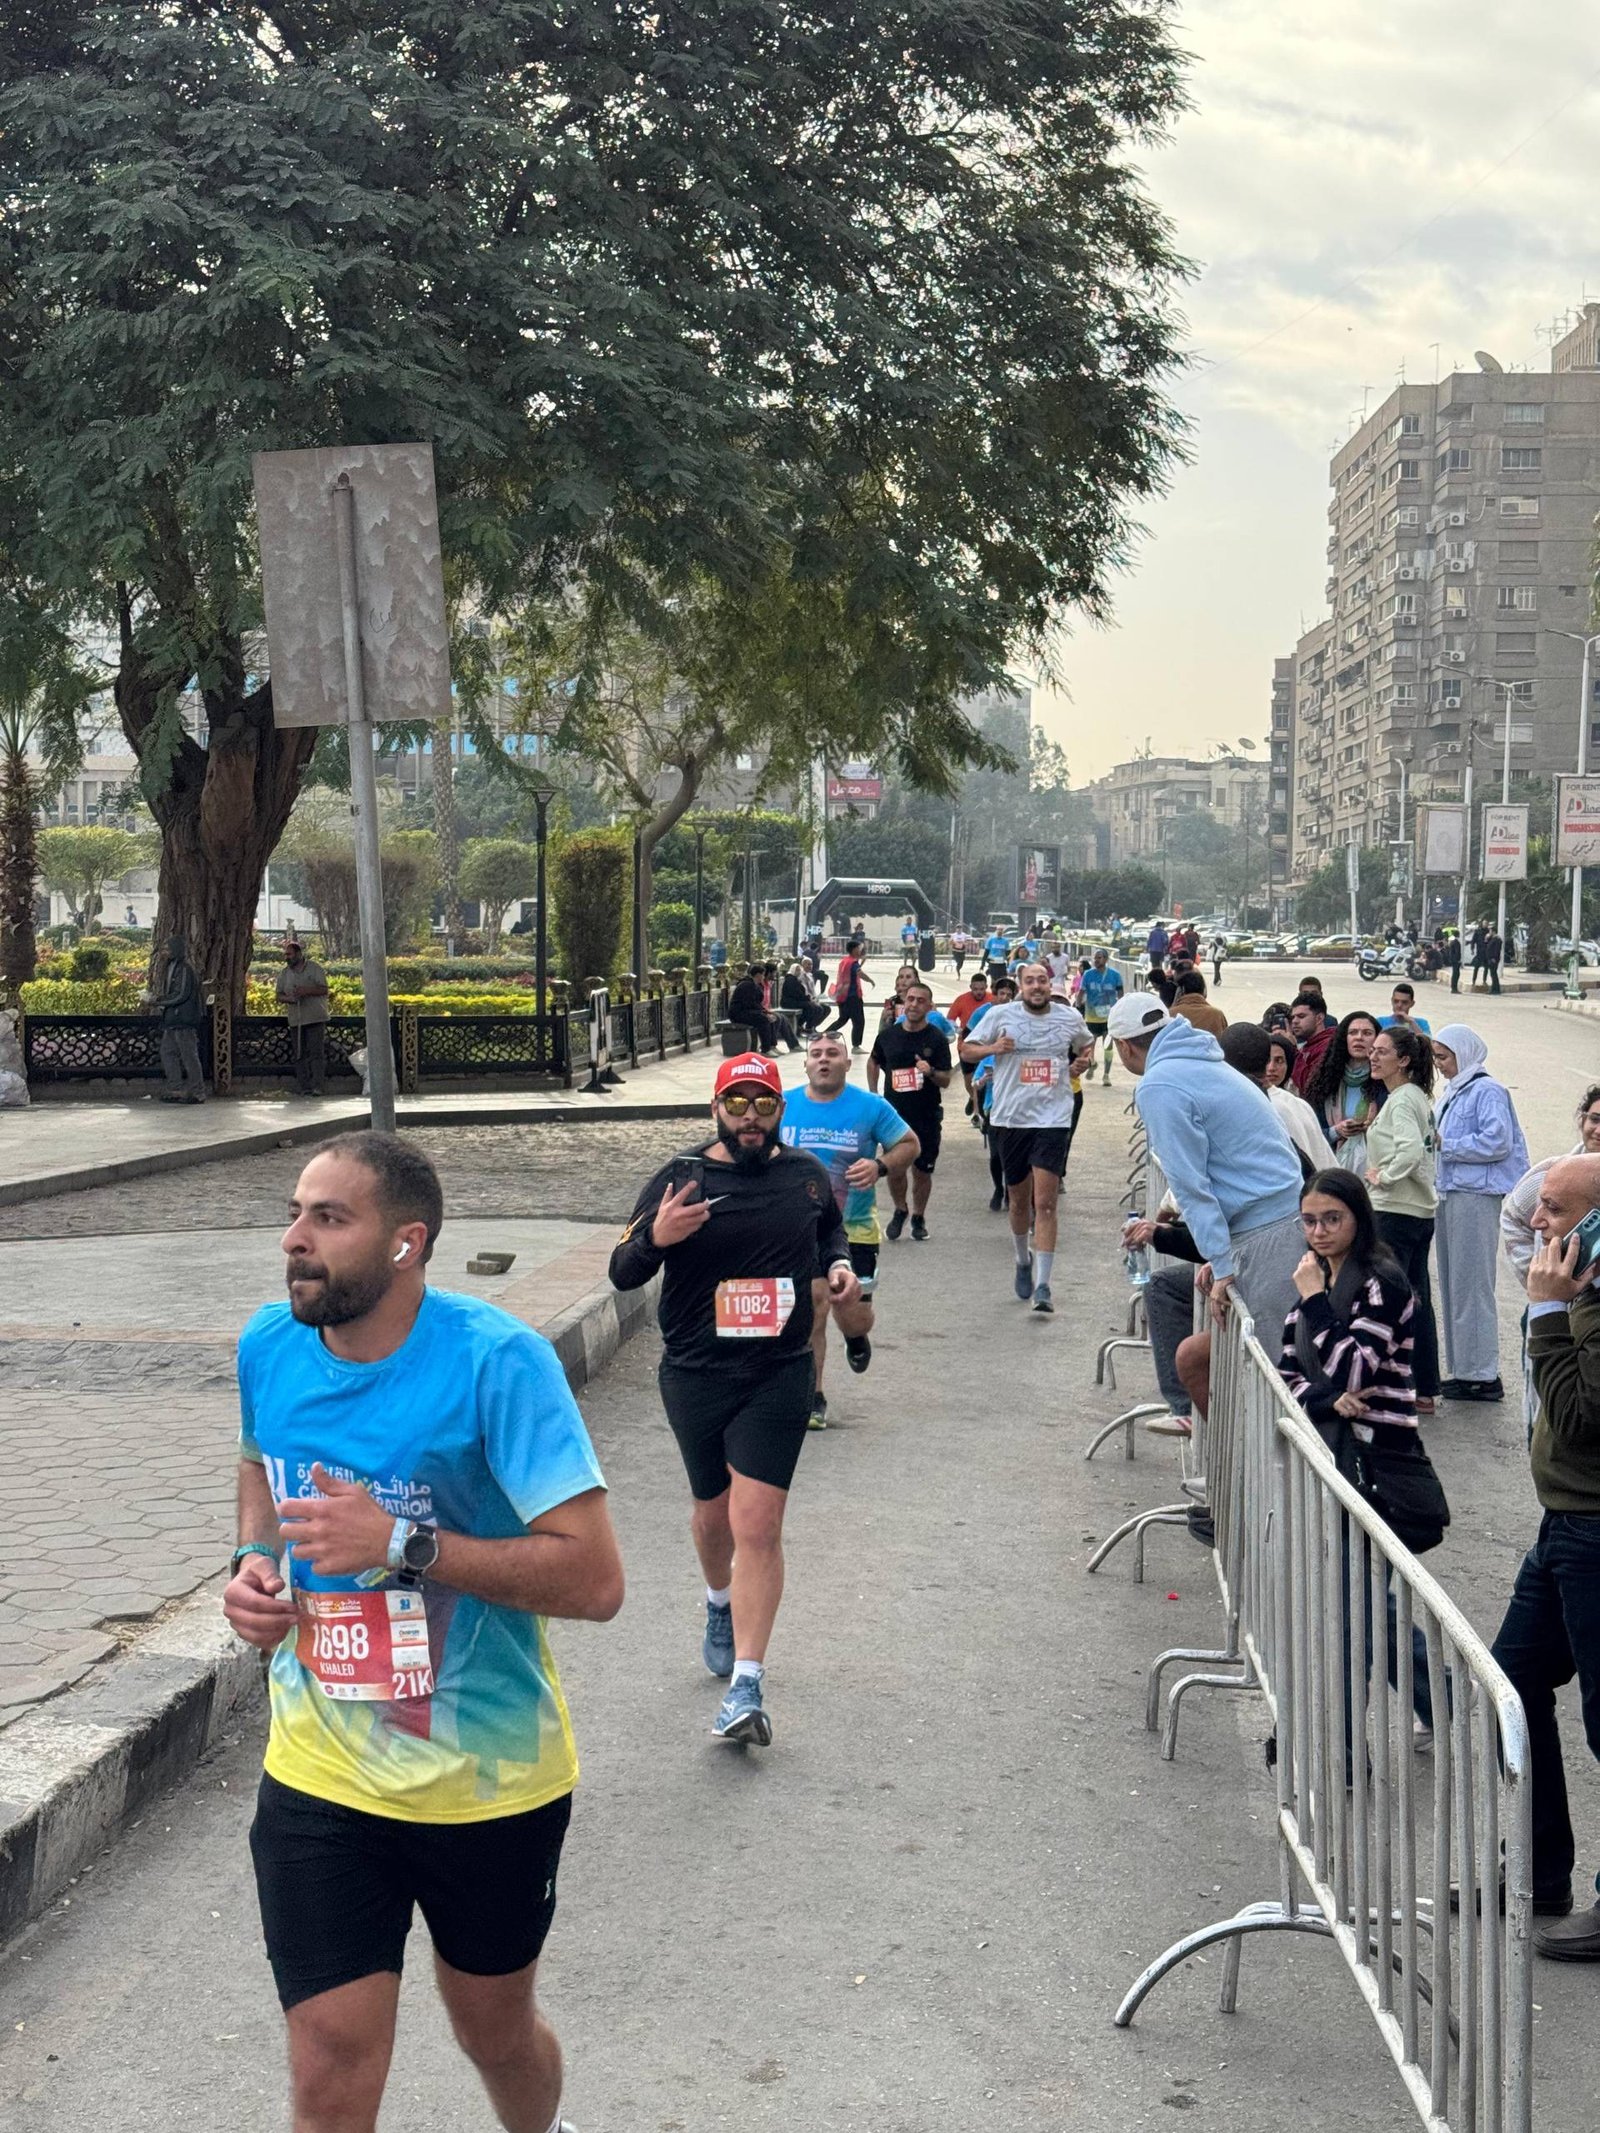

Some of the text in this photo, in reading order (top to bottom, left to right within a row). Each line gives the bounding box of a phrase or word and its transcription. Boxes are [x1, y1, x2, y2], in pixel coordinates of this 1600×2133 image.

[1566, 783, 1580, 791] FOR
[730, 1064, 763, 1077] PUMA
[798, 1134, 819, 1142] CAIRO
[723, 1295, 770, 1315] 11082
[312, 1622, 370, 1661] 1698
[319, 1661, 355, 1677] KHALED
[391, 1669, 434, 1700] 21K
